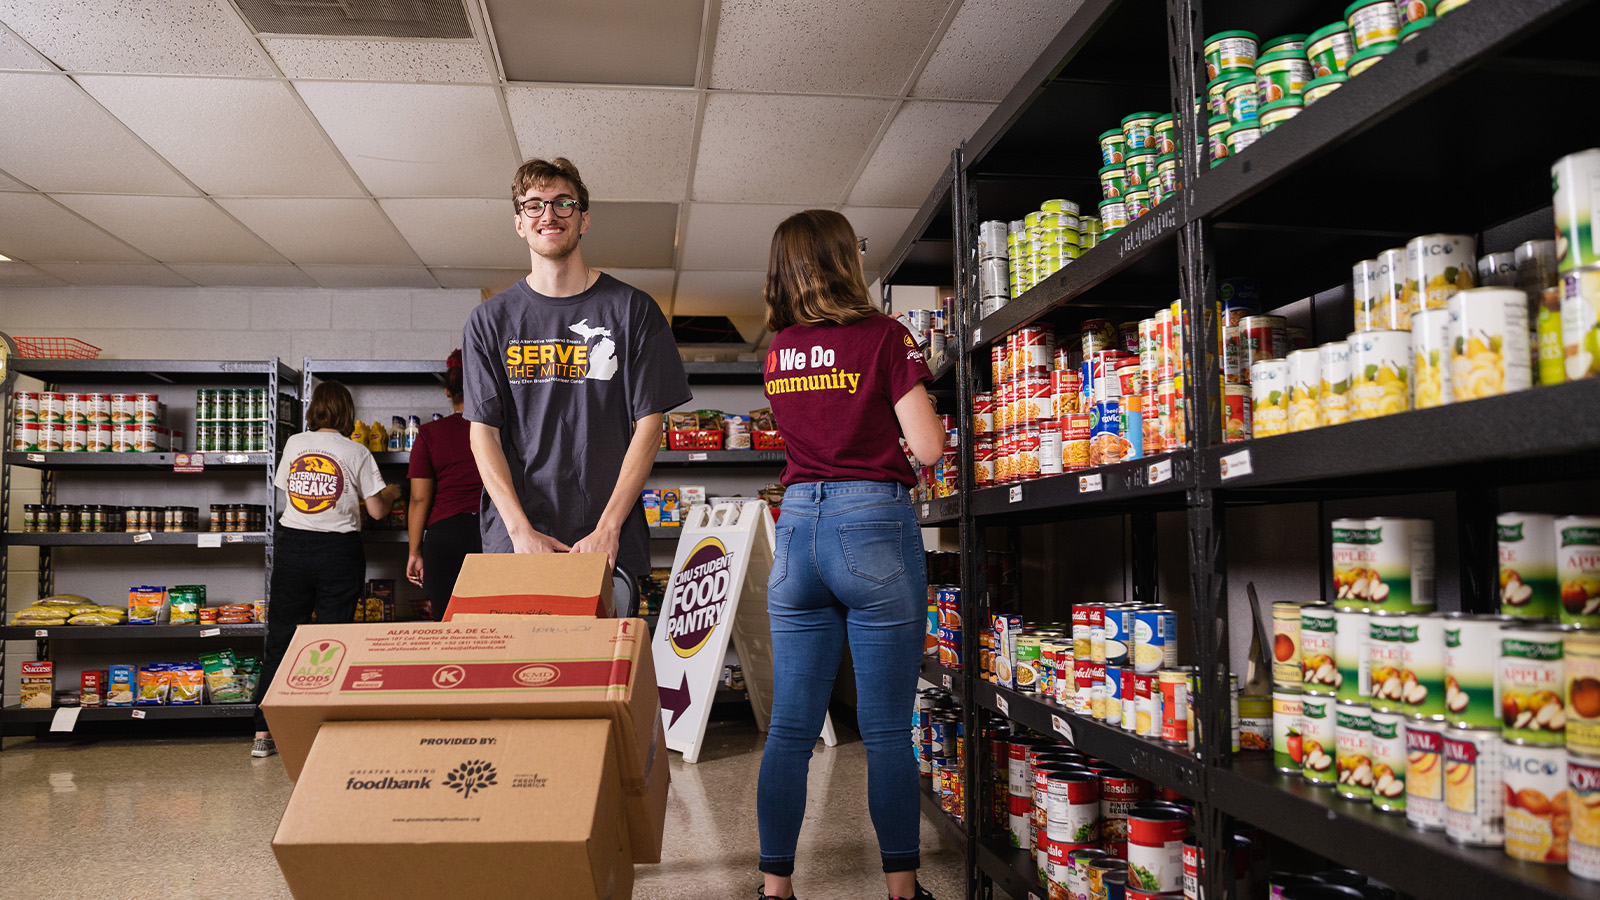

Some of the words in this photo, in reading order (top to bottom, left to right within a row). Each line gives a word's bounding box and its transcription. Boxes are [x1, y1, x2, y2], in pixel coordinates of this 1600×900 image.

[506, 343, 588, 366] SERVE
[780, 347, 806, 371] We
[811, 345, 835, 368] Do
[507, 365, 535, 378] THE
[540, 363, 587, 378] MITTEN
[766, 368, 860, 395] ommunity
[289, 471, 338, 485] ALTERNATIVE
[289, 480, 337, 496] BREAKS
[674, 568, 694, 587] CMU
[693, 553, 734, 579] STUDENT
[669, 569, 730, 617] FOOD
[664, 599, 727, 641] PANTRY
[22, 664, 51, 673] Success
[296, 667, 333, 676] ALFA
[420, 737, 477, 746] PROVIDED
[479, 737, 497, 746] BY:
[345, 776, 432, 790] foodbank
[1103, 780, 1140, 793] Teasdale
[1109, 802, 1131, 810] PINTO
